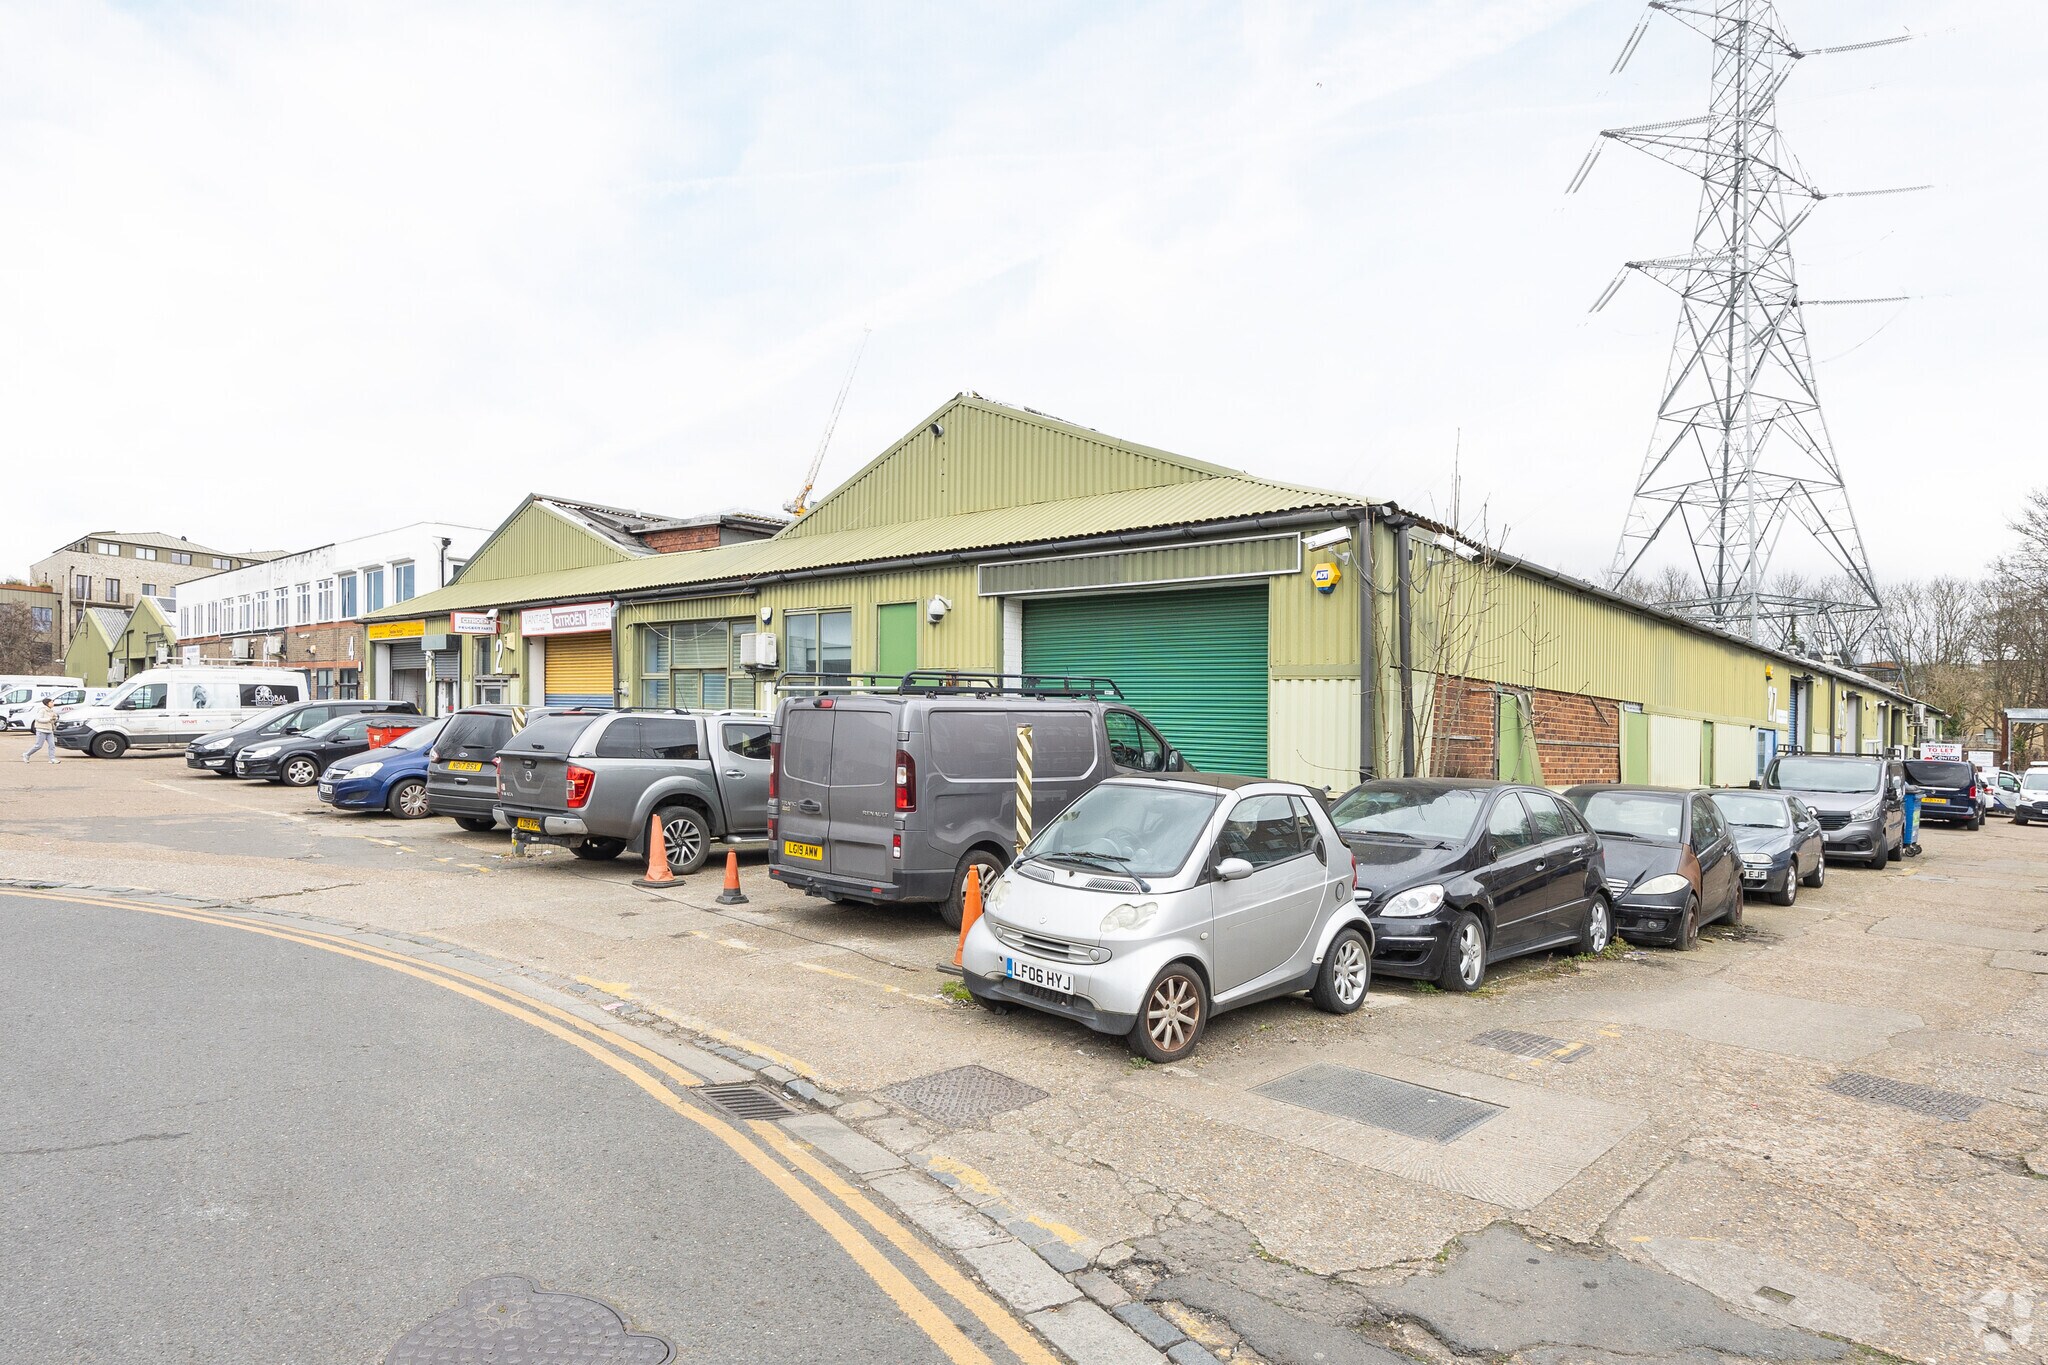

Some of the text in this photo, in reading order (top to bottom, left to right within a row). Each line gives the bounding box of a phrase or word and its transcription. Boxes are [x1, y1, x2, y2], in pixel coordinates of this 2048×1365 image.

[524, 613, 550, 625] VANTAGE
[553, 611, 586, 627] CITROËN
[588, 607, 610, 619] PARTS
[349, 636, 354, 661] 4
[495, 639, 503, 673] 2
[862, 810, 889, 818] RENAULT
[788, 843, 818, 858] LG19 AMW
[1014, 961, 1071, 991] LF06 HYJ
